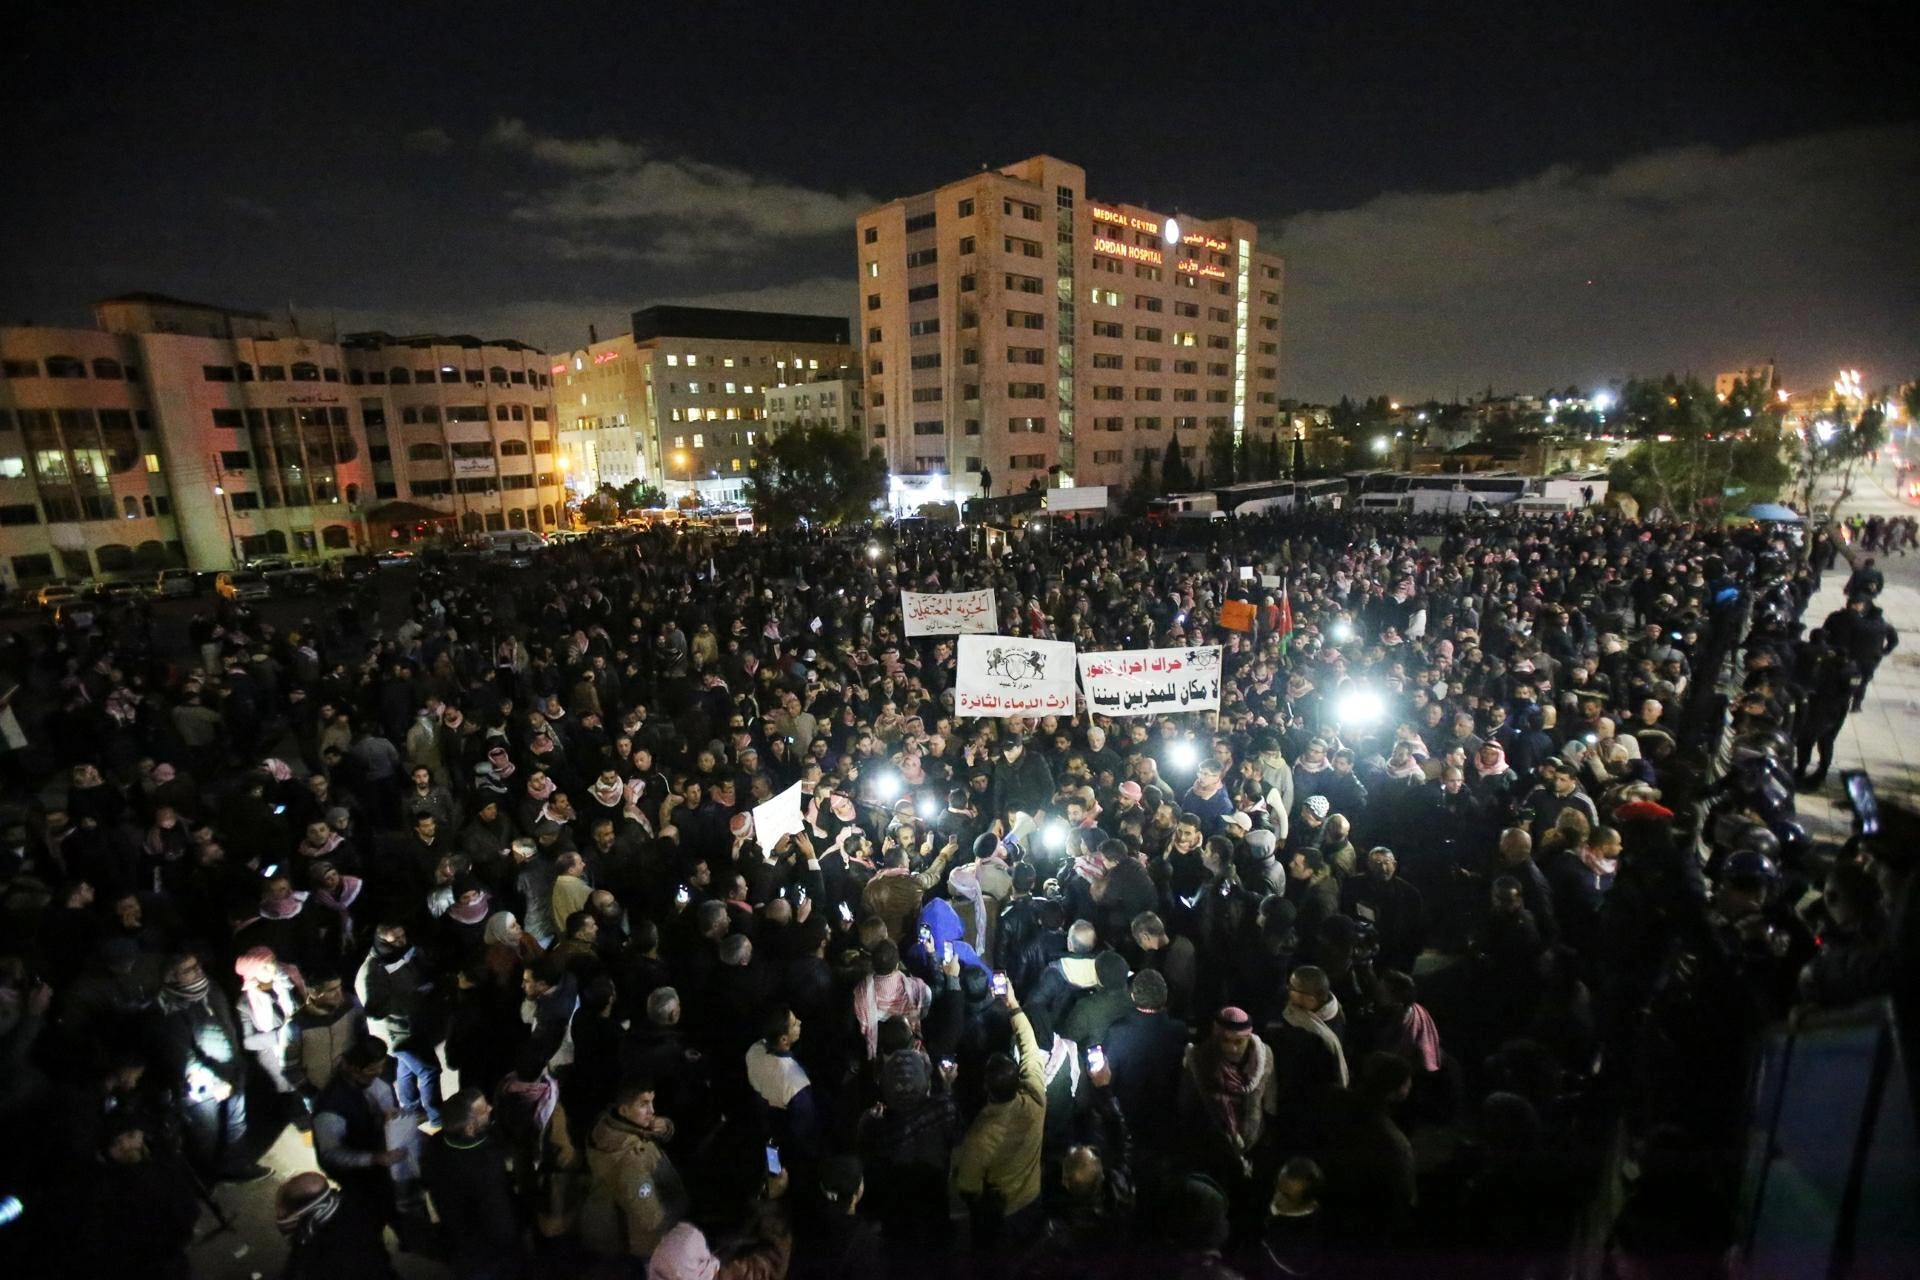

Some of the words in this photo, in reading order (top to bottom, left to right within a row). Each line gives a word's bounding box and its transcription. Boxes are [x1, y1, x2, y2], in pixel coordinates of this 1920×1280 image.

[1093, 207, 1128, 226] MEDICAL
[1131, 218, 1158, 234] CENTER
[1094, 239, 1127, 257] JORDAN
[1128, 246, 1162, 265] HOSPITAL
[1118, 658, 1147, 676] احرار
[1151, 657, 1182, 673] حراك
[1092, 685, 1120, 710] بيننا
[1123, 682, 1176, 710] للمخربين
[1180, 679, 1207, 705] مكان
[1211, 678, 1218, 698] لا
[961, 693, 1001, 709] الثائرة
[1004, 697, 1042, 710] الدماء
[1046, 694, 1069, 709] ارث
